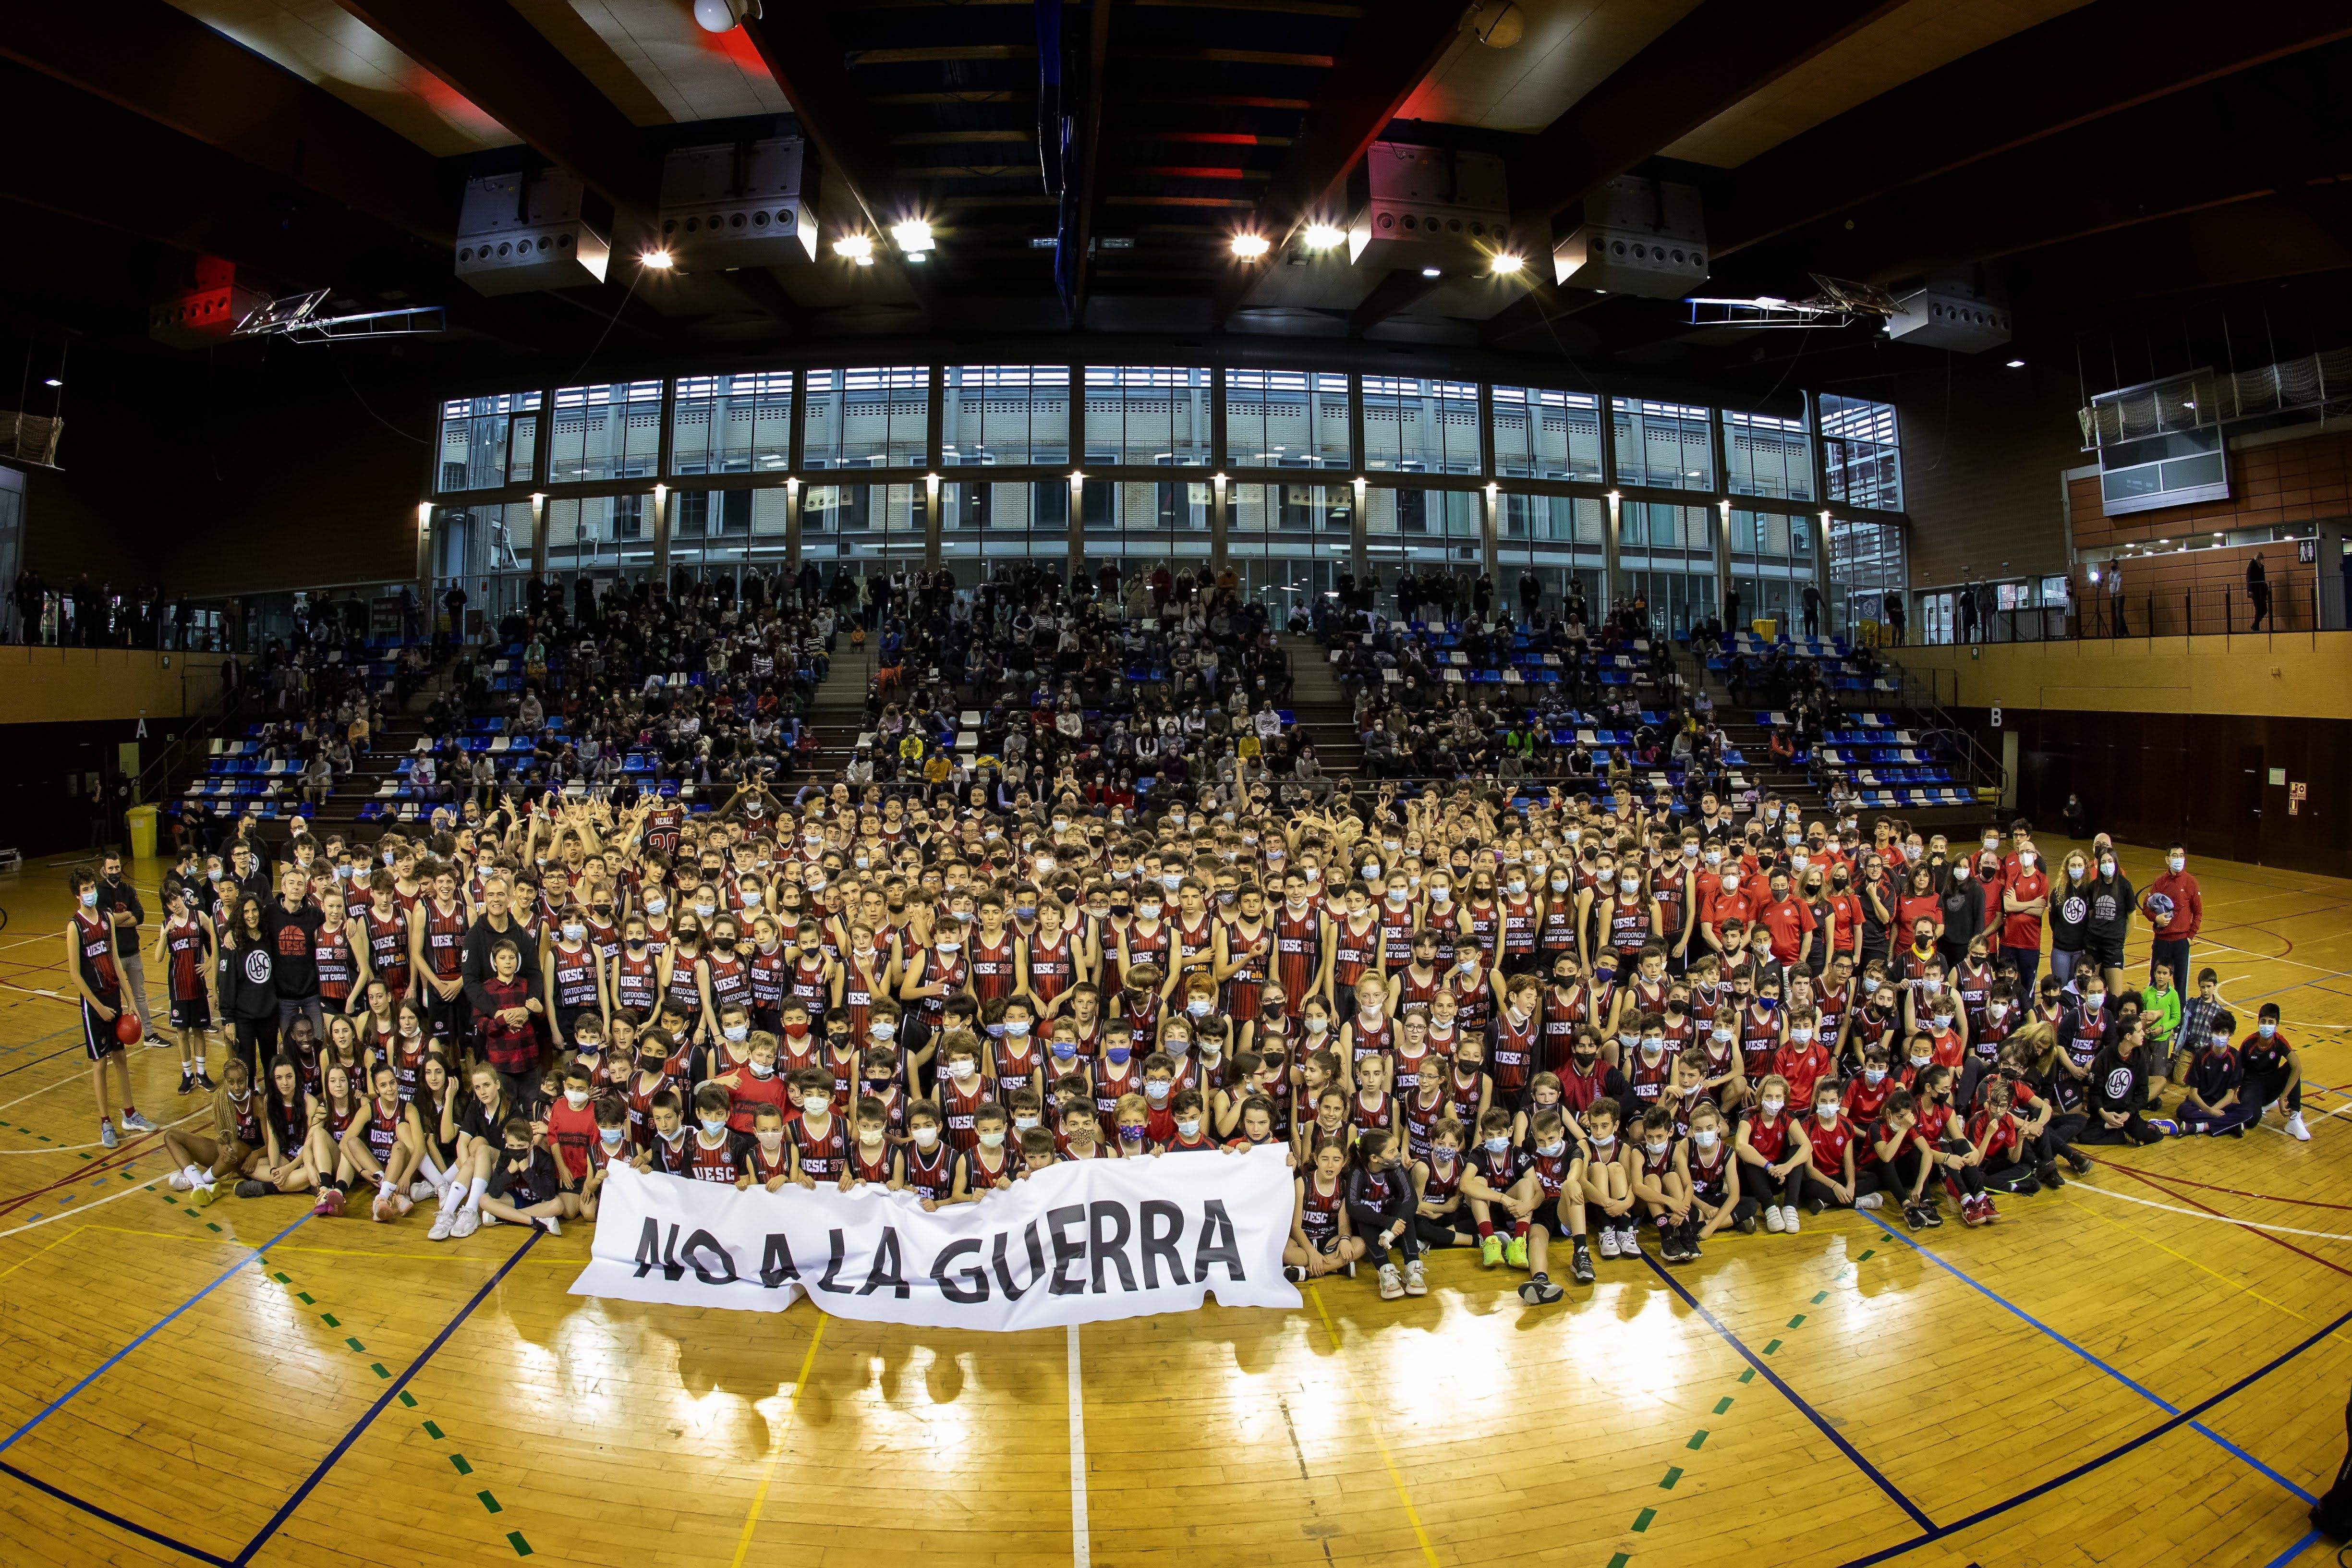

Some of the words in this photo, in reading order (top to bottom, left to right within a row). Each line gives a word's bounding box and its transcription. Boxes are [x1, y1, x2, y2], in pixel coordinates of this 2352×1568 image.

[1991, 707, 2001, 727] B
[136, 718, 148, 738] A
[655, 817, 673, 825] NEALE
[1550, 914, 1564, 924] ESC
[1613, 917, 1636, 929] UESC
[1473, 922, 1488, 931] ESC
[550, 931, 559, 941] SC
[1385, 927, 1401, 938] ESC
[373, 936, 395, 950] UESC
[432, 935, 452, 947] UESC
[1279, 939, 1301, 951] UESC
[1303, 943, 1314, 953] 91
[86, 940, 108, 957] UESC
[334, 948, 347, 959] 23
[603, 943, 619, 958] ESC
[1182, 947, 1195, 956] ESC
[1104, 949, 1117, 960] UES
[1132, 953, 1152, 963] UESC
[1337, 950, 1359, 961] UESC
[974, 963, 996, 974] UESC
[999, 964, 1012, 973] 25
[1056, 963, 1069, 974] 26
[559, 968, 583, 982] UESC
[673, 971, 691, 982] ESC
[752, 969, 769, 980] UESC
[772, 972, 783, 982] 71
[621, 976, 641, 986] UESC
[715, 976, 740, 991] UESC
[564, 985, 595, 997] ORTODONCI
[671, 987, 699, 996] RTODONC
[753, 984, 779, 993] TODONCIA
[795, 986, 813, 996] UESC
[1719, 982, 1733, 992] UES
[722, 991, 751, 1003] ORTODONC
[1962, 990, 1982, 1000] UESC
[1699, 1021, 1711, 1030] ESC
[1820, 1015, 1834, 1026] ESC
[1546, 1022, 1571, 1034] UESC
[1663, 1040, 1680, 1050] ESC
[1746, 1039, 1767, 1049] UESC
[1977, 1043, 1997, 1053] UESC
[2072, 1038, 2093, 1050] UESC
[1496, 1052, 1521, 1064] UESC
[393, 1067, 415, 1082] USC
[937, 1066, 953, 1079] UES
[836, 1080, 848, 1090] SC
[1001, 1076, 1026, 1089] UESC
[1398, 1075, 1419, 1087] UESC
[1634, 1084, 1658, 1095] UESC
[1097, 1099, 1117, 1111] UES
[1455, 1103, 1465, 1113] SC
[630, 1109, 642, 1125] ESC
[948, 1116, 974, 1129] UESC
[371, 1130, 393, 1143] UESC
[1410, 1137, 1431, 1148] TODONC
[801, 1159, 826, 1172] UESC
[831, 1159, 844, 1171] 37
[693, 1167, 735, 1181] UESC
[915, 1186, 934, 1200] SC
[1303, 1212, 1328, 1223] UESC
[633, 1216, 741, 1285] NO
[759, 1233, 801, 1289] A
[817, 1226, 910, 1299] LA
[930, 1200, 1246, 1303] GUERRA
